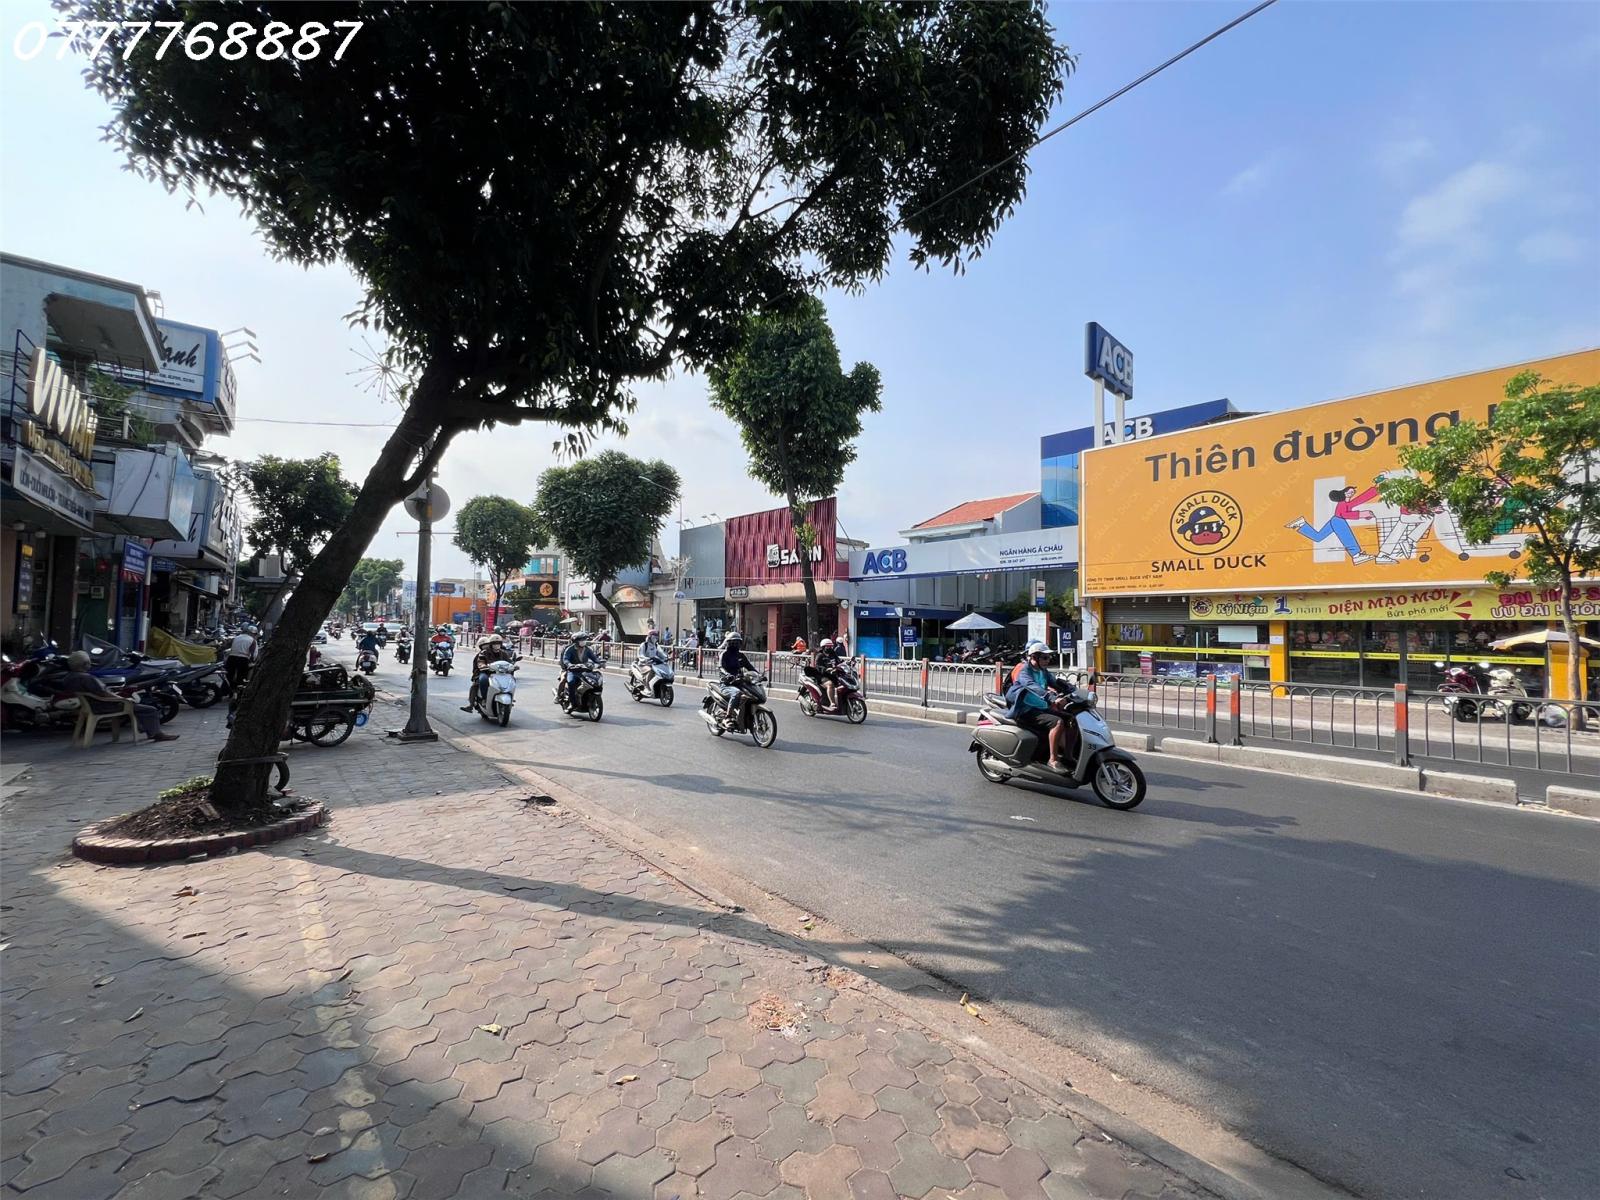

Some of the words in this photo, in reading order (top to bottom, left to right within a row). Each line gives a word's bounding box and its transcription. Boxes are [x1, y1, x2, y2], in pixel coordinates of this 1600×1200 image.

[1098, 335, 1134, 386] ACB
[1104, 417, 1154, 445] ACB
[1145, 443, 1256, 483] Thiên
[1176, 495, 1208, 525] SMALL
[1211, 494, 1238, 521] DUCK
[862, 549, 907, 575] ACB
[999, 549, 1018, 557] NGÂN
[1018, 546, 1037, 555] HÀNG
[1043, 544, 1063, 553] CHÂU
[1151, 558, 1205, 573] SMALL
[1214, 555, 1267, 570] DUCK
[1234, 603, 1268, 617] Niệm
[1274, 595, 1293, 615] 1
[1328, 600, 1364, 615] DIỆN
[1368, 594, 1408, 610] MẠO
[1386, 609, 1405, 618] Bứt
[1408, 606, 1427, 616] phá
[1429, 604, 1449, 614] mới
[1521, 603, 1551, 617] ĐÃI
[1062, 631, 1072, 640] ACB
